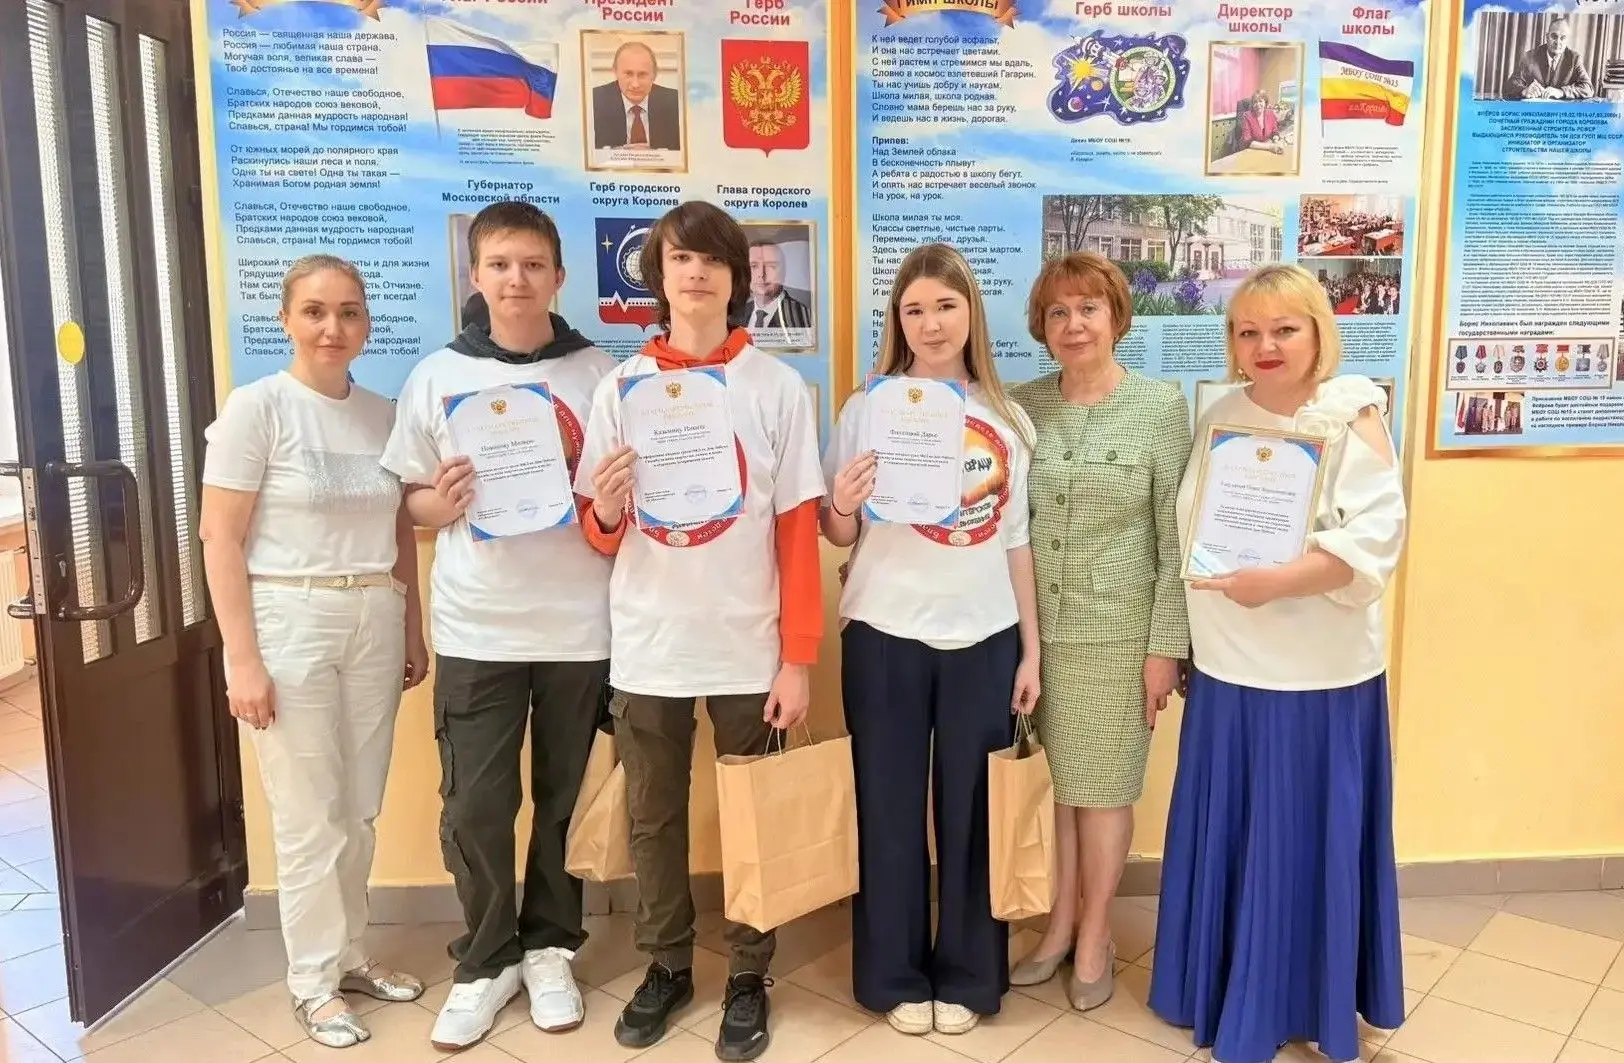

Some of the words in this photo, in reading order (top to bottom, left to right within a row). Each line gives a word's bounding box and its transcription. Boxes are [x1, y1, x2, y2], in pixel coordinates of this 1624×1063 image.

[602, 8, 664, 22] России
[1075, 2, 1112, 18] Герб
[1118, 5, 1172, 17] школы
[1217, 4, 1293, 20] Директор
[1352, 7, 1391, 20] Флаг
[730, 11, 790, 25] России
[1229, 21, 1283, 33] школы
[1342, 23, 1395, 35] школы
[467, 179, 533, 191] Губернатор
[589, 182, 616, 195] Герб
[619, 184, 681, 195] городского
[717, 185, 748, 195] Глава
[751, 186, 811, 197] городского
[442, 192, 510, 203] Московской
[513, 194, 560, 204] области
[592, 197, 629, 207] округа
[632, 196, 679, 206] Королев
[724, 199, 759, 209] округа
[762, 198, 808, 208] Королев
